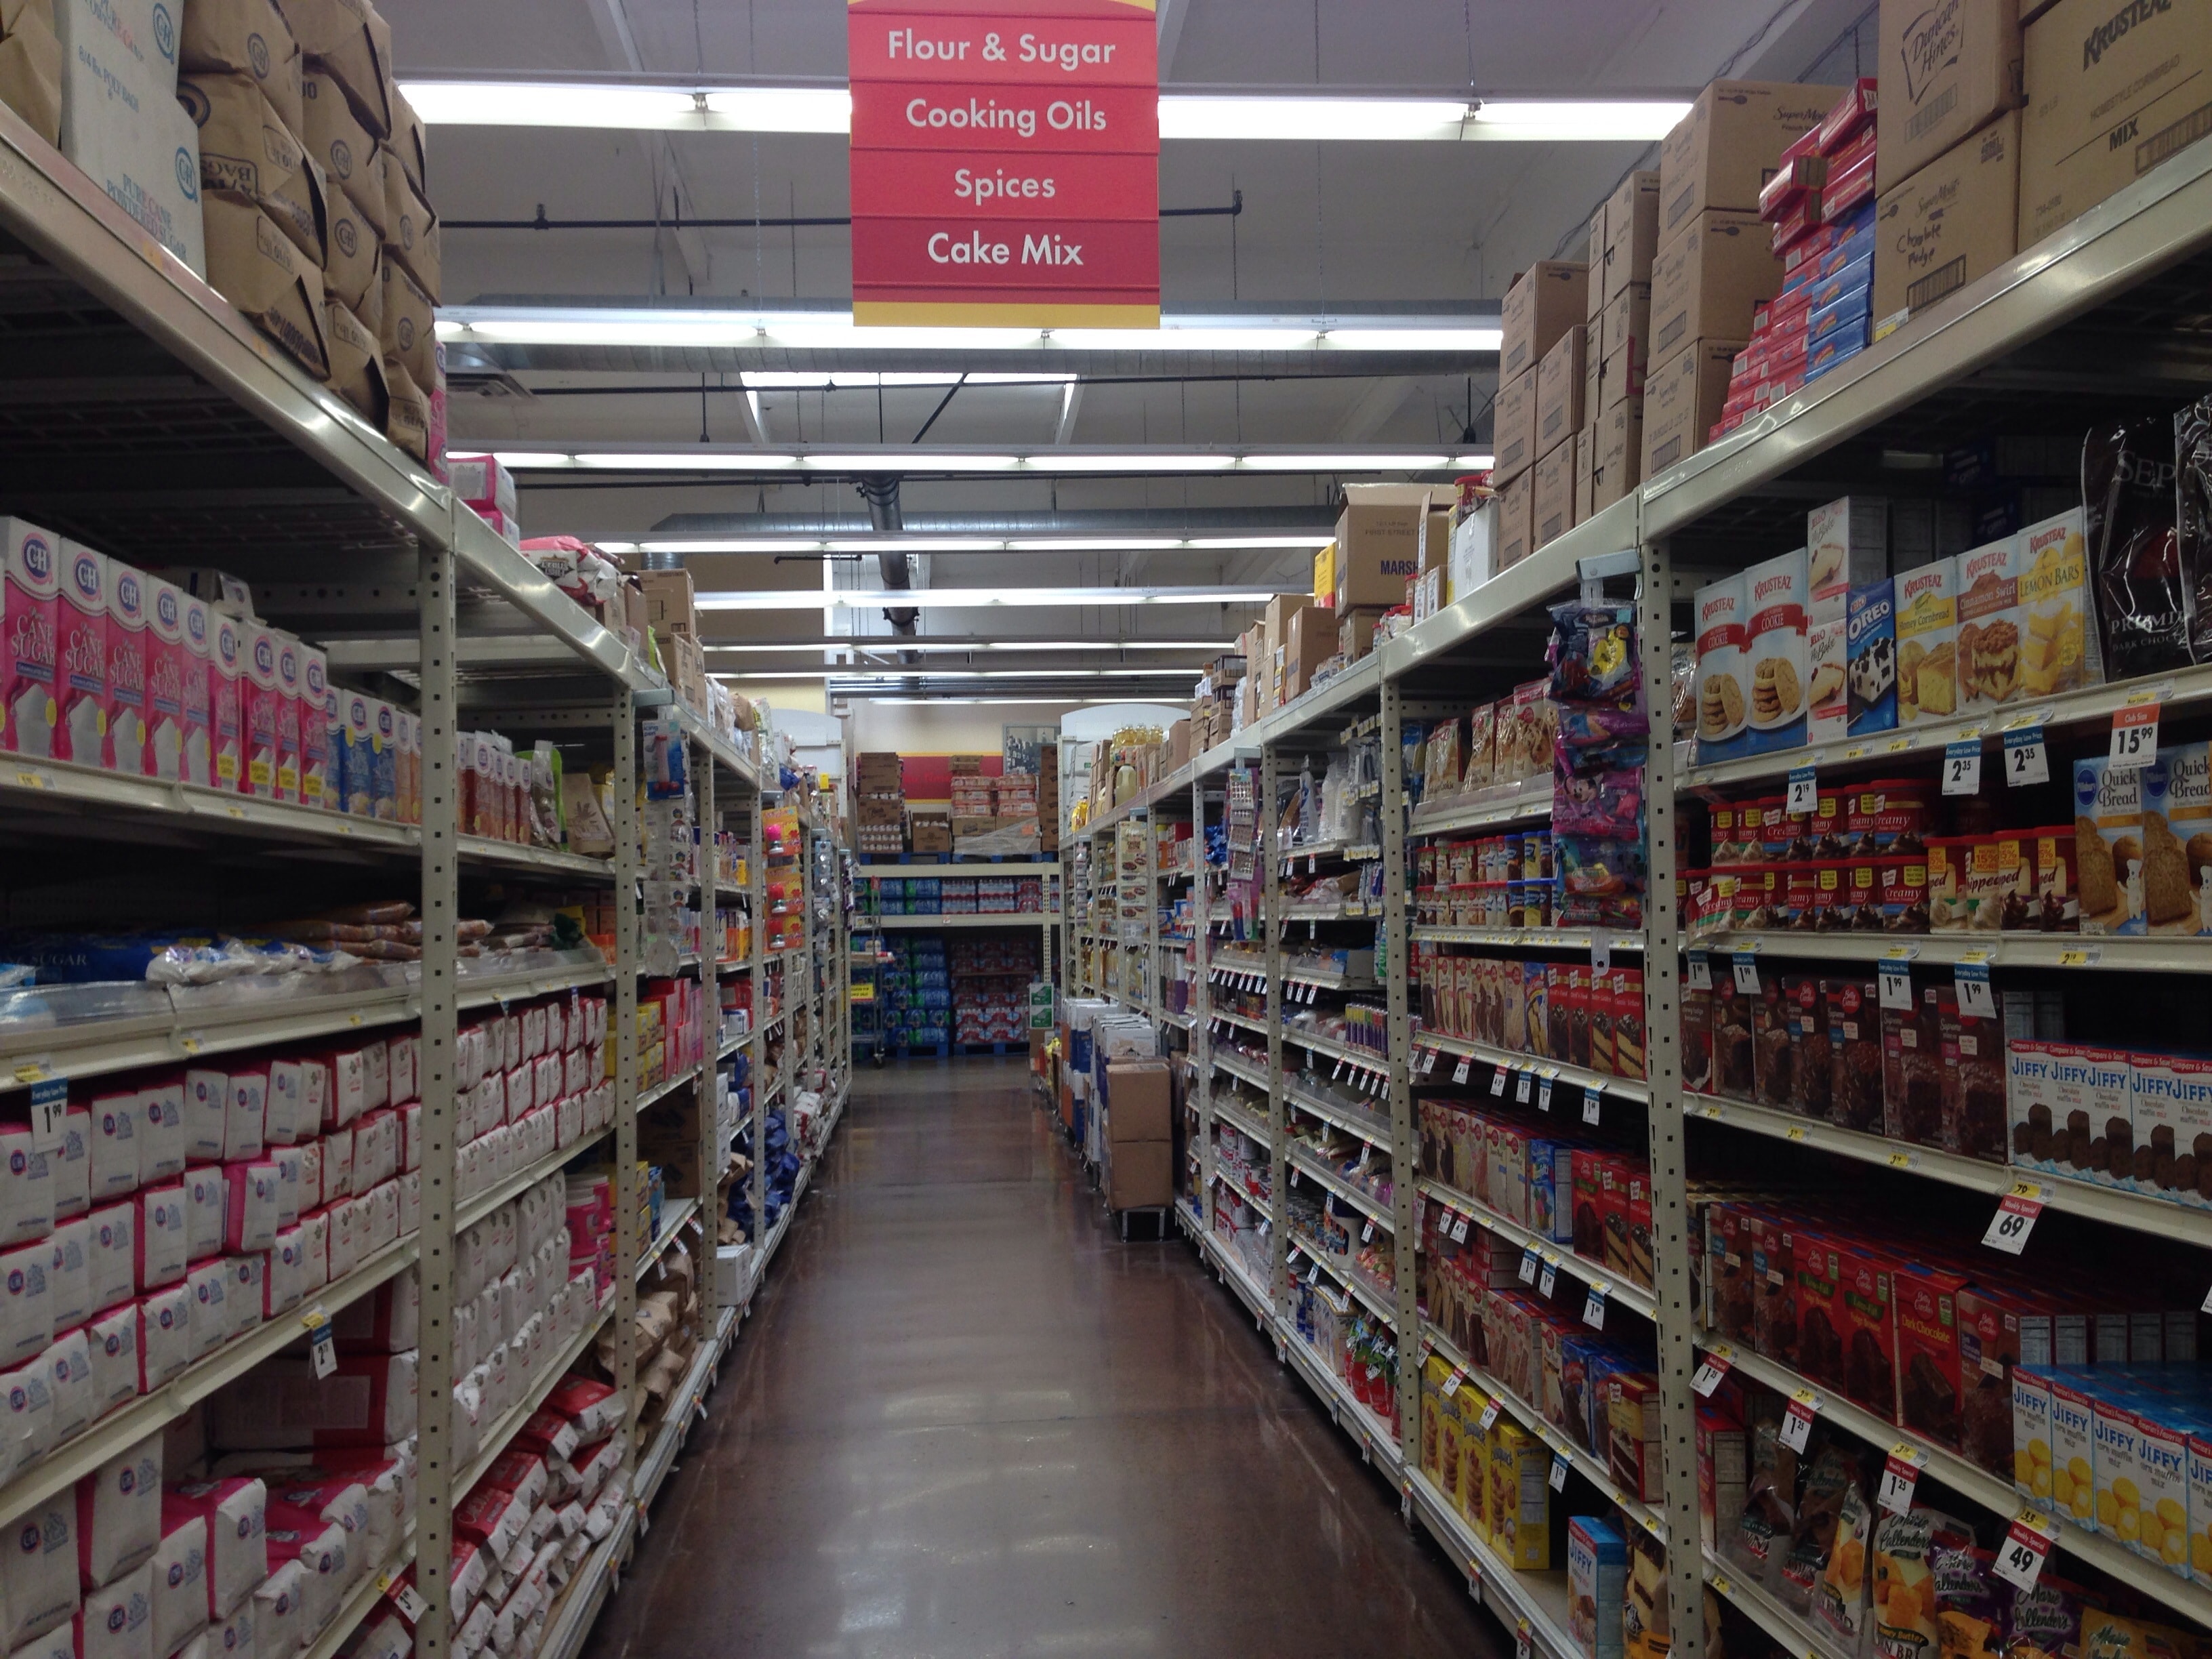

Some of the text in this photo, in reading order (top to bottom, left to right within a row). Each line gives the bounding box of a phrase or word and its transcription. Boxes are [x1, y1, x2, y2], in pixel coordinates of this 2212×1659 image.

[888, 28, 1115, 70] Flour & Sugar
[1918, 24, 1956, 83] Hines
[906, 98, 1106, 137] Cooking Oils
[2110, 117, 2138, 152] MIX
[954, 169, 1055, 205] Spices
[928, 230, 1084, 266] Cake Mix
[2030, 527, 2066, 553] KRUSTEAZ
[1967, 552, 2008, 579] KRUSTEAZ
[1755, 575, 1792, 602] KRUSTEAZ
[1904, 575, 1942, 599] KRUSTEAZ
[2020, 565, 2079, 597] LEMON BARS
[1961, 590, 1994, 609] Cinnamon
[1996, 583, 2015, 598] Swirl
[1702, 597, 1735, 621] KRUSTEAZ
[1848, 600, 1891, 640] OREO
[1899, 617, 1917, 631] Honey
[1918, 609, 1950, 626] Cornbread
[17, 615, 52, 644] CANE
[1762, 613, 1784, 630] COOKIE
[11, 635, 56, 665] SUGAR
[1708, 632, 1728, 649] COOKIE
[2112, 640, 2137, 652] DARK
[65, 649, 105, 677] SUGAR
[110, 662, 144, 691] SUGAR
[2125, 715, 2137, 723] Club
[1946, 746, 1963, 756] Everyday
[2004, 736, 2023, 745] Everyday
[2174, 756, 2210, 781] Quick
[2102, 769, 2137, 792] Quick
[2169, 777, 2211, 798] Bread
[2098, 786, 2138, 807] Bread
[1885, 887, 1921, 900] Creamy
[1702, 898, 1734, 913] Creamy
[2011, 1042, 2030, 1051] Compare
[2050, 1045, 2069, 1055] Compare
[2013, 1057, 2047, 1078] JIFFY
[2051, 1061, 2087, 1082] JIFFY
[2131, 1055, 2152, 1066] Compare
[2089, 1067, 2127, 1089] JIFFY
[2133, 1071, 2173, 1095] JIFFY
[2141, 1099, 2165, 1109] Chocolate
[2182, 1105, 2209, 1117] Chocolate
[2005, 1197, 2037, 1215] Weekly Special
[1902, 1313, 1950, 1344] Dark Chocolate
[2014, 1385, 2047, 1414] JIFFY
[2053, 1402, 2089, 1433] JIFFY
[2067, 1429, 2087, 1443] muffin
[2095, 1420, 2135, 1452] JIFFY
[2138, 1419, 2183, 1443] America's Favorite
[2097, 1442, 2133, 1464] corn muffin
[2139, 1439, 2182, 1472] JIFFY
[1889, 1460, 1914, 1477] Weekly Special
[2140, 1461, 2181, 1483] corn muffin
[2190, 1459, 2212, 1485] JIF
[2151, 1477, 2165, 1489] mix
[1880, 1530, 1931, 1552] Callender's
[2013, 1528, 2044, 1551] Weekly Special
[1568, 1538, 1592, 1576] JIFFY
[2014, 1607, 2070, 1632] Callender's
[1898, 1631, 1923, 1643] Butter
